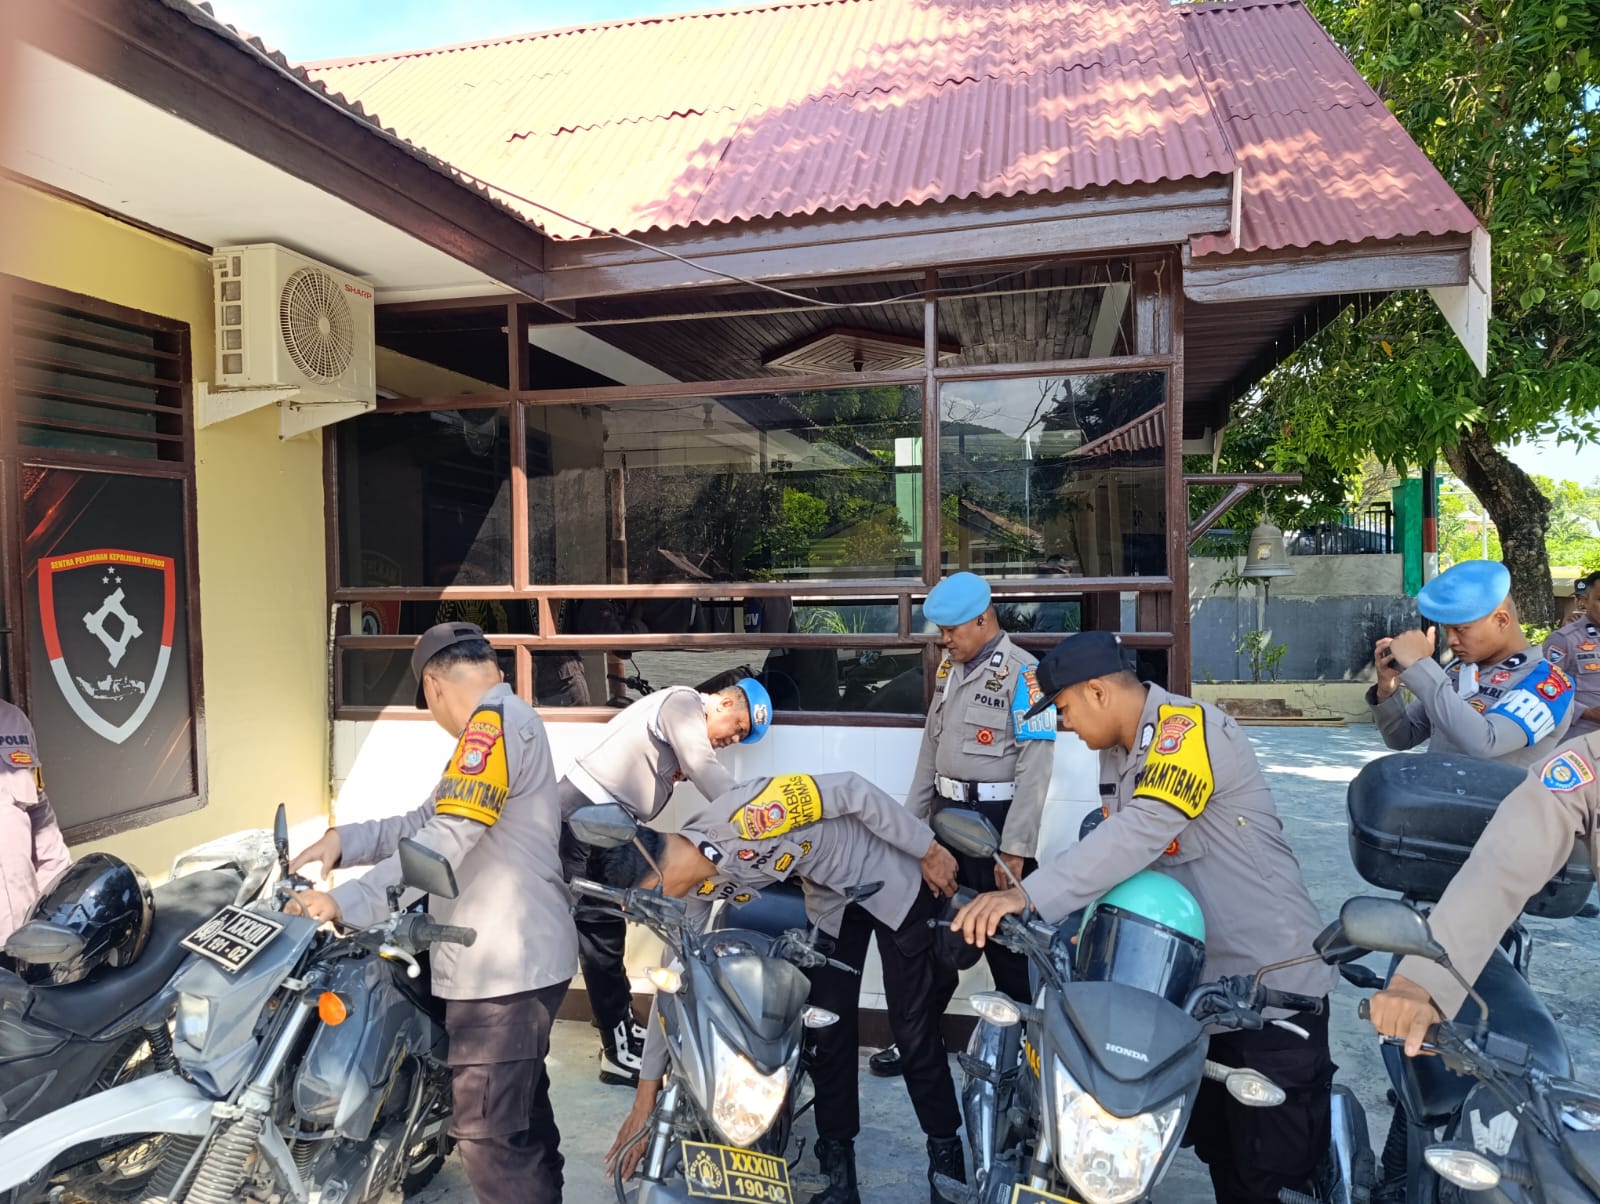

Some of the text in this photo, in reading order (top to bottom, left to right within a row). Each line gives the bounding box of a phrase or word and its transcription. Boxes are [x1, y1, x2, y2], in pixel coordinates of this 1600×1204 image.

[344, 283, 373, 299] SHARP
[50, 558, 75, 570] SENTRA
[974, 693, 1005, 708] POLRI
[0, 735, 30, 746] POLRI
[1105, 1042, 1149, 1062] HONDA
[730, 1151, 780, 1180] XXXIII
